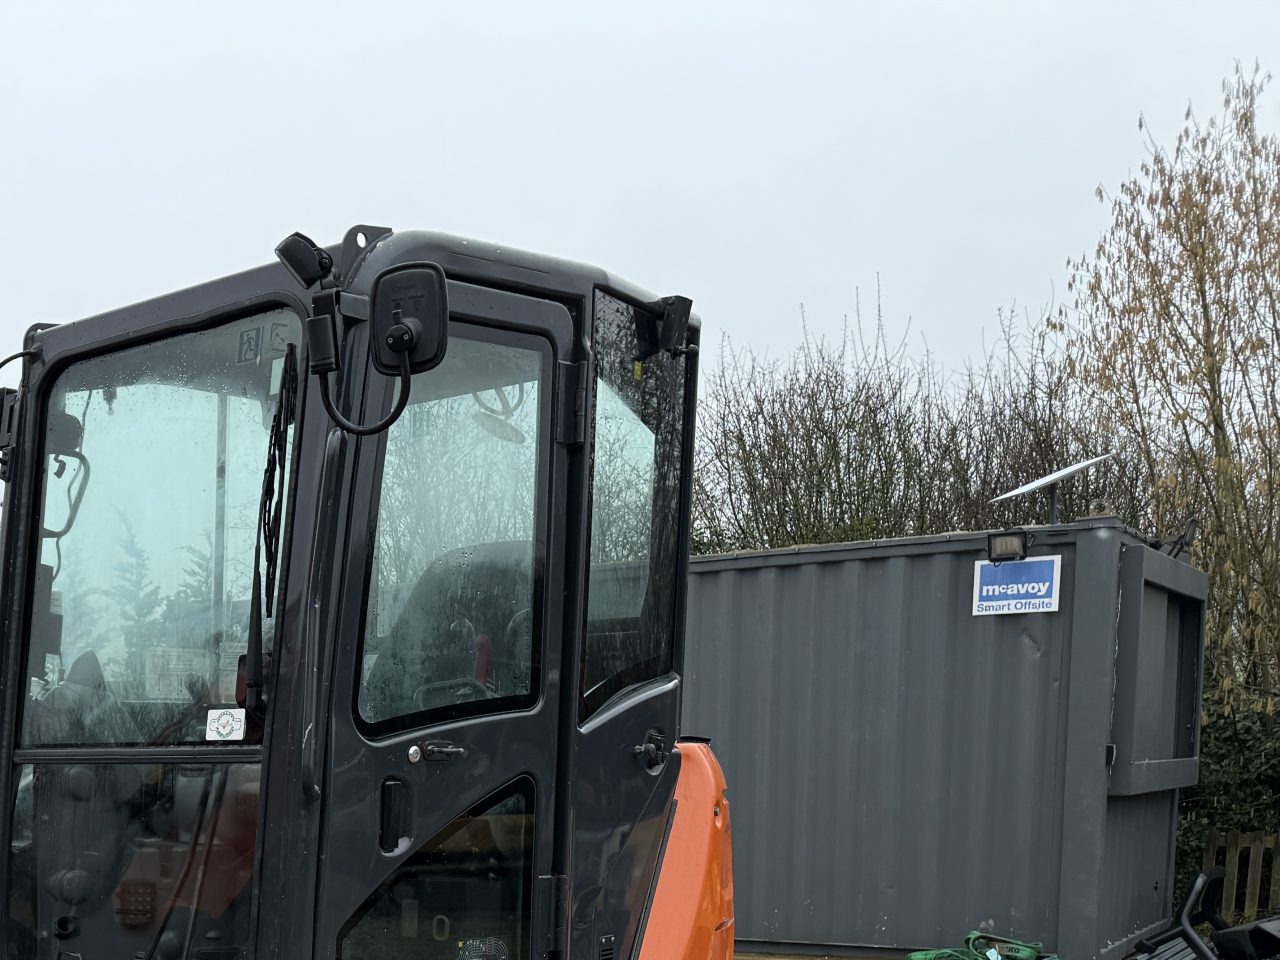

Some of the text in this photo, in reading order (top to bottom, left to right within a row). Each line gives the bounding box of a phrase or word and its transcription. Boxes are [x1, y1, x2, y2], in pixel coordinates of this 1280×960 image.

[982, 581, 1050, 596] mcavoy
[977, 600, 1053, 613] Smart Offsite
